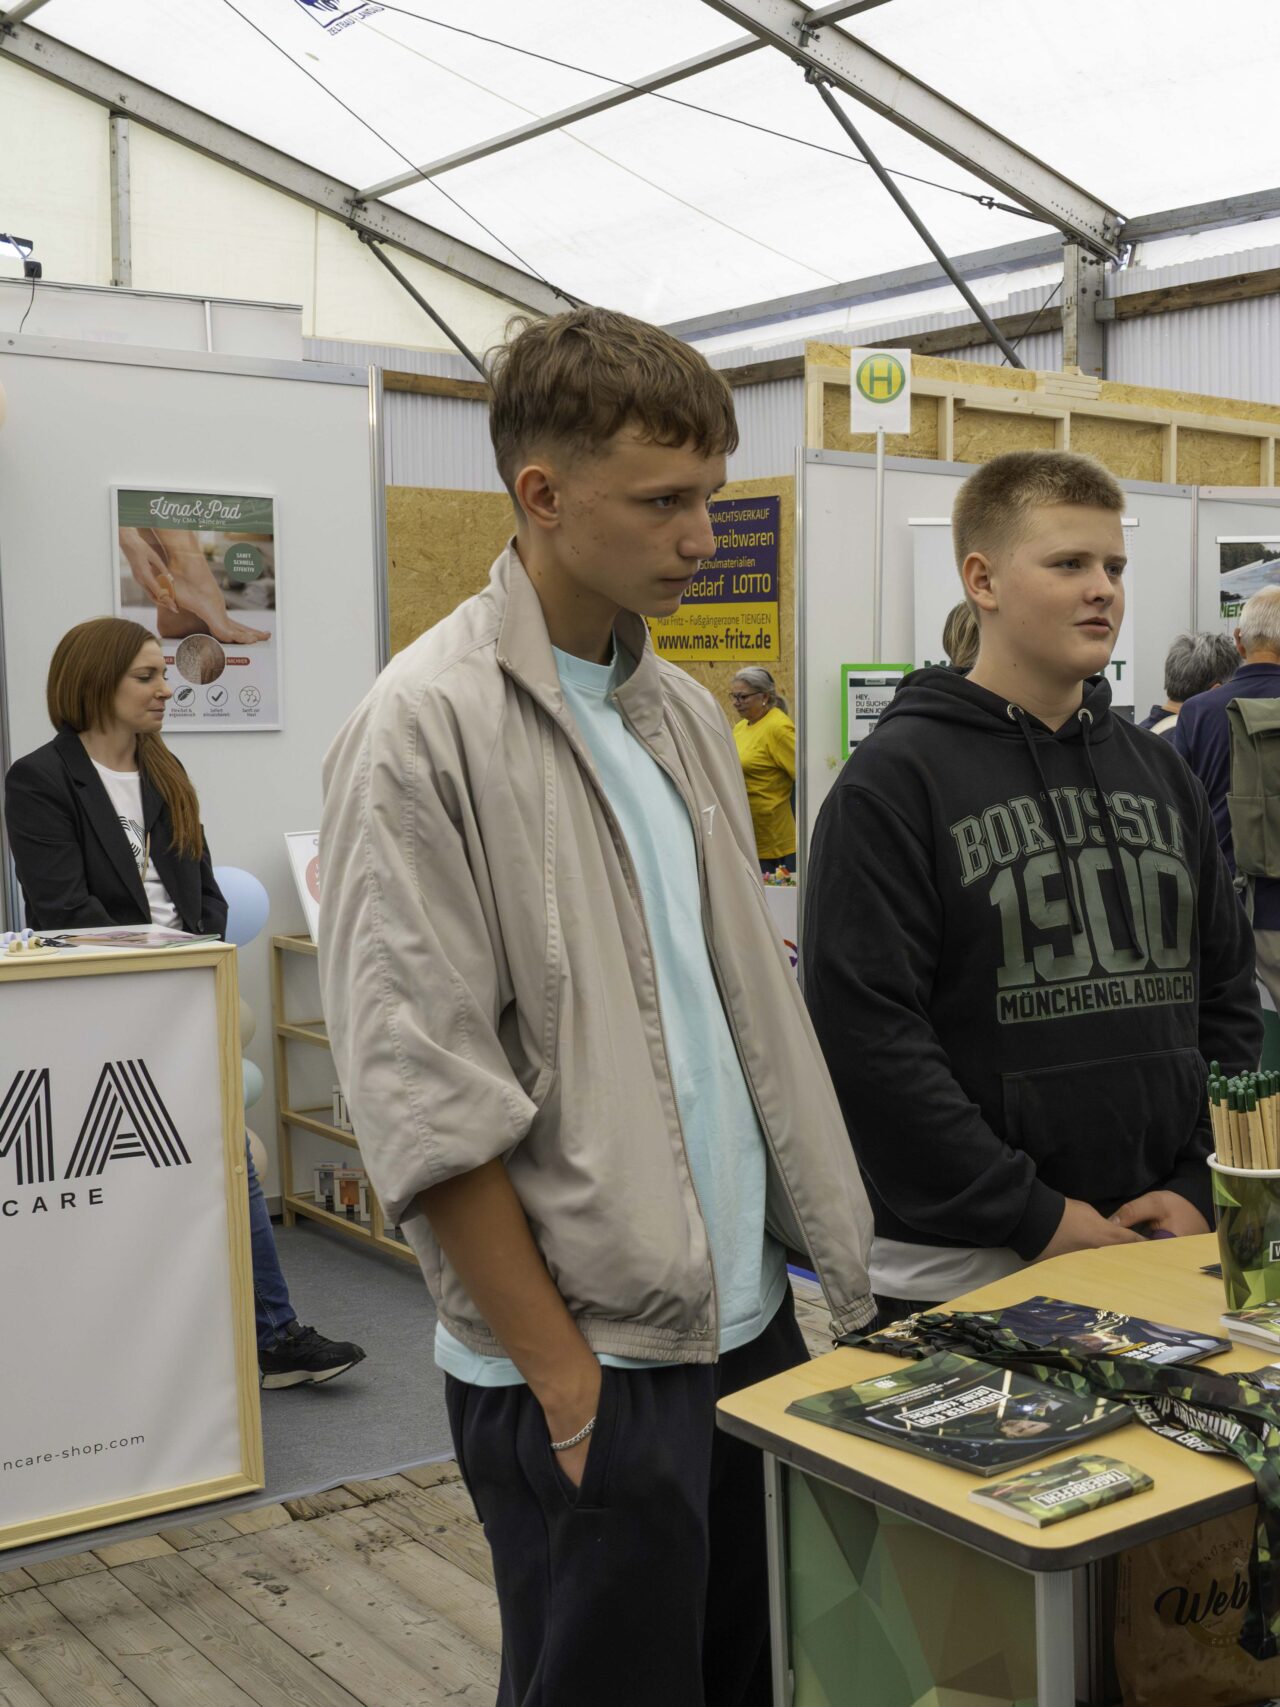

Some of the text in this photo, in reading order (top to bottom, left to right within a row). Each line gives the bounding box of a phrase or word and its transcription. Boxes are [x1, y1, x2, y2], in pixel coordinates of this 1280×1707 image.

[709, 507, 770, 523] SNACHTSVERKAUF
[713, 529, 775, 549] reibwaren
[733, 573, 771, 594] LOTTO
[657, 628, 772, 650] www.max-fritz.de
[988, 846, 1196, 988] 1900
[1001, 975, 1193, 1021] MÖNCHENGLADBACH
[3, 1435, 145, 1471] ncare-shop.com
[1037, 1470, 1124, 1505] TAGESBEFEHL
[1154, 1572, 1249, 1626] Web
